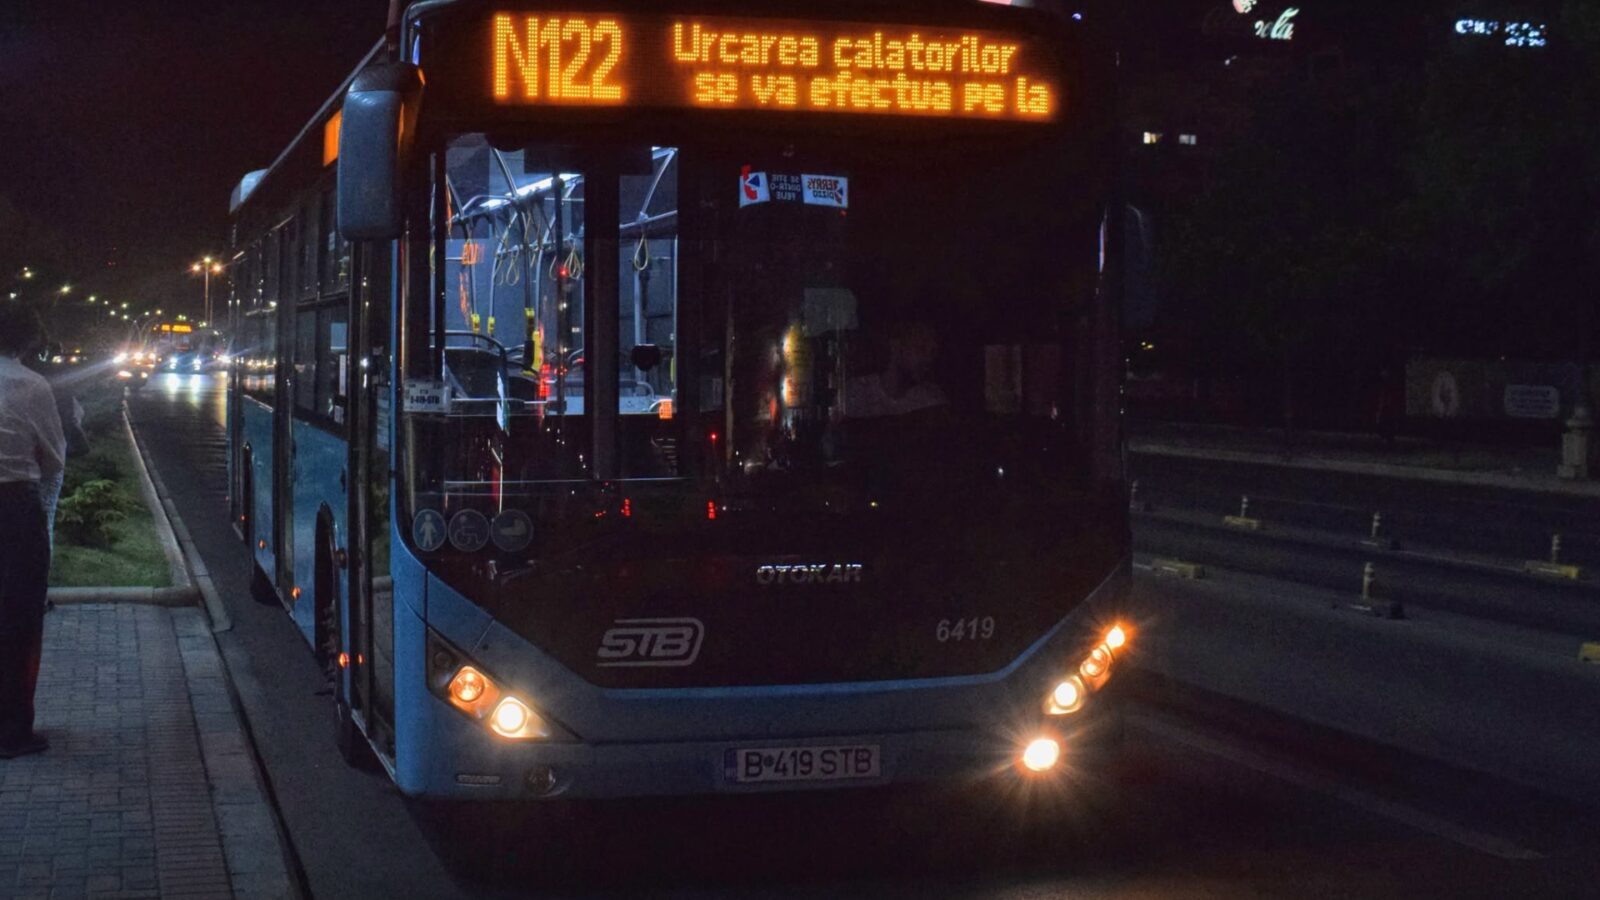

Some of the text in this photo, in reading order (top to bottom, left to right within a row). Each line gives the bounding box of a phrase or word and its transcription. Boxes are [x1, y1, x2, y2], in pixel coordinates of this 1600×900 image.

[496, 16, 622, 99] N122
[674, 23, 1017, 74] Urcarea calatorilor
[695, 70, 1048, 113] se va efectua pe la
[756, 563, 863, 584] OTOKAR
[597, 626, 694, 658] STB
[936, 616, 995, 642] 6419
[821, 748, 872, 775] STB
